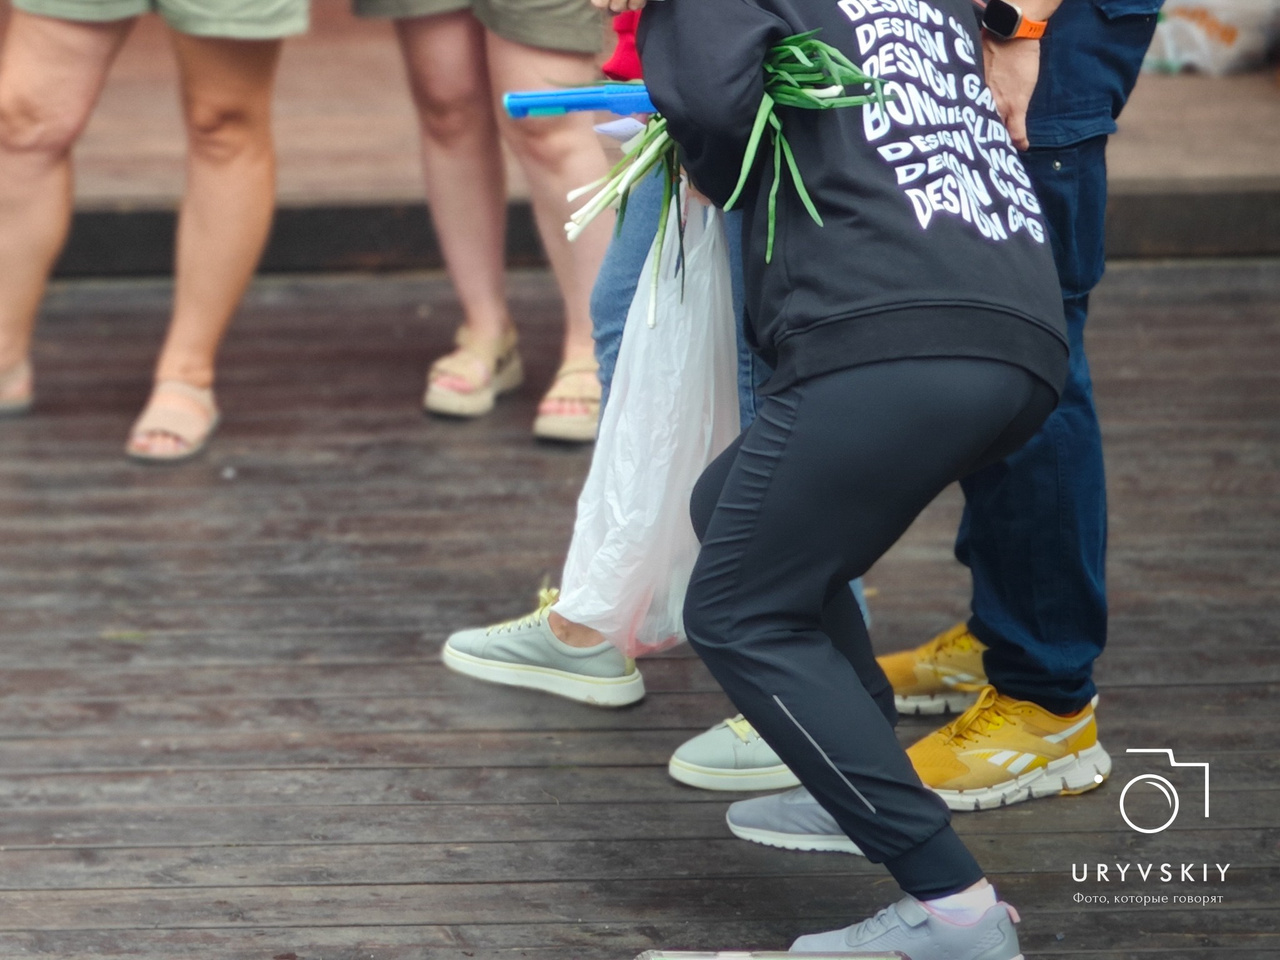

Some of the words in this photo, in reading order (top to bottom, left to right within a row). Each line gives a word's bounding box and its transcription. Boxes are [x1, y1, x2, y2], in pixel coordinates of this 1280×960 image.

[855, 17, 949, 64] DESIGN
[862, 42, 958, 100] DESIGN
[862, 81, 964, 142] BONNIE
[877, 130, 975, 162] DESIGN
[904, 174, 1008, 240] DESIGN
